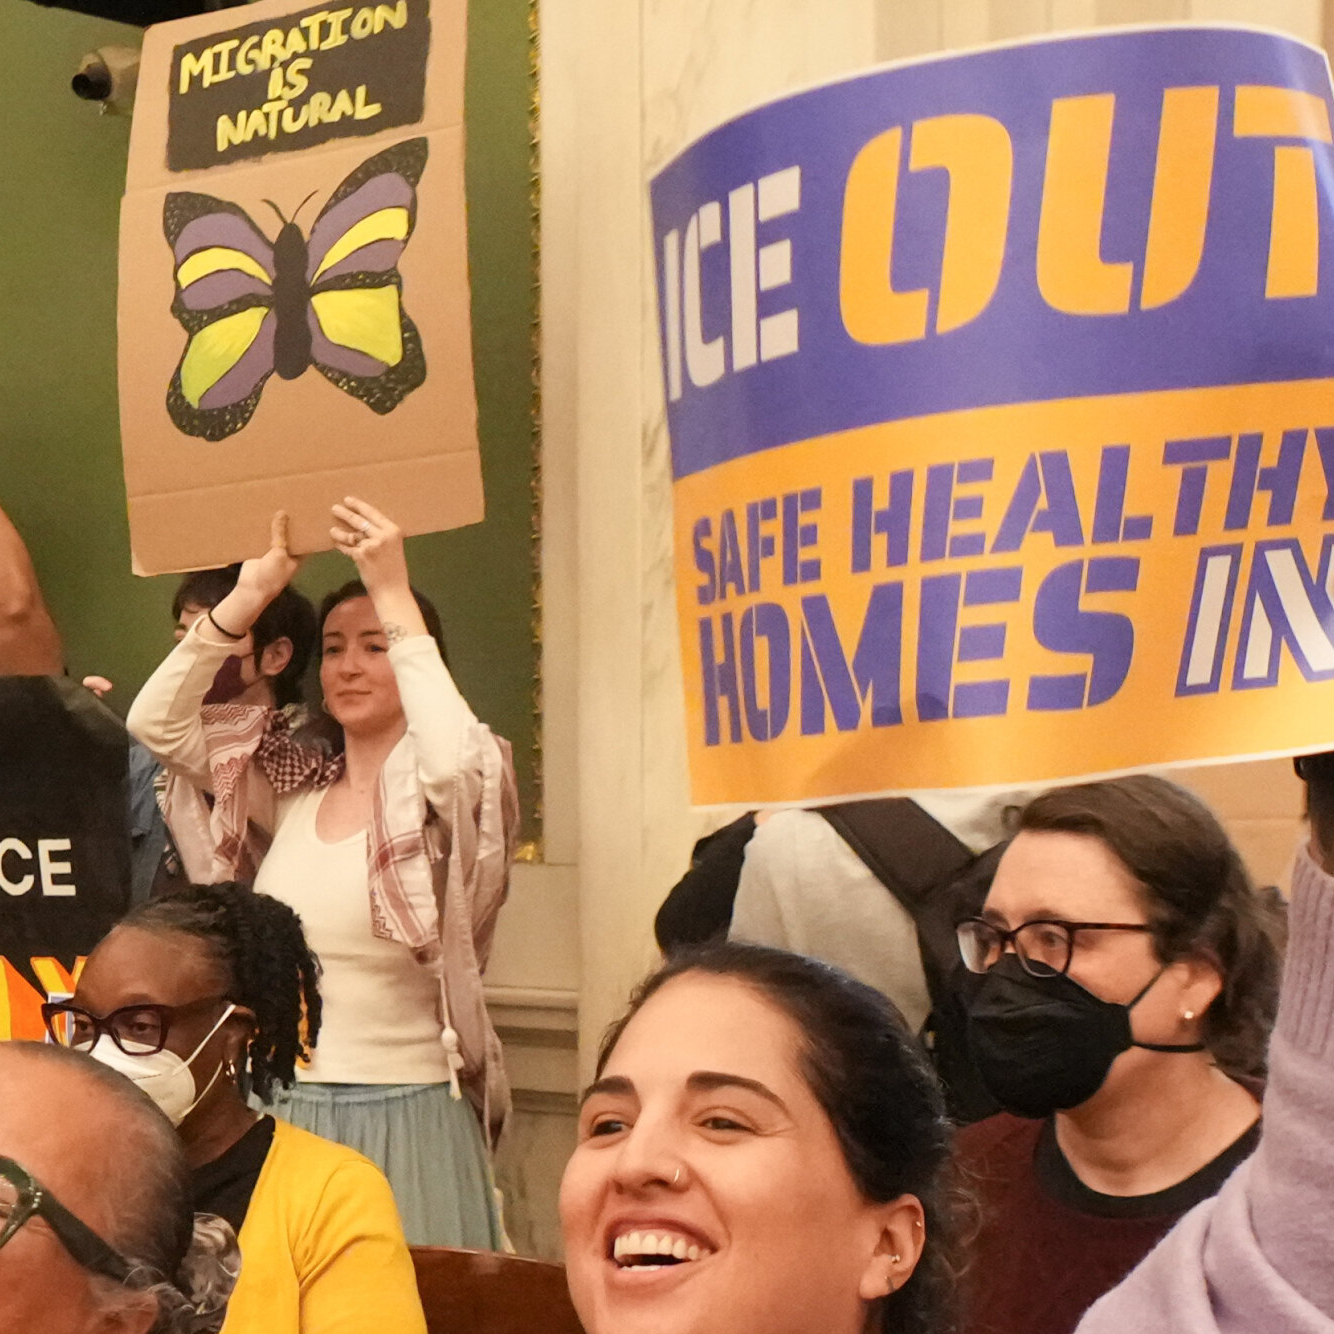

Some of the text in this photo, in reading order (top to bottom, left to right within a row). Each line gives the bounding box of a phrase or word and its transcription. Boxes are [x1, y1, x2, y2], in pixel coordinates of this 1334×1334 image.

[178, 0, 408, 94] MIGRATION
[267, 57, 313, 100] IS
[216, 84, 382, 152] NATURAL
[660, 83, 1334, 402] ICE OUT
[692, 487, 823, 606] SAFE
[697, 554, 1139, 749] HOMES
